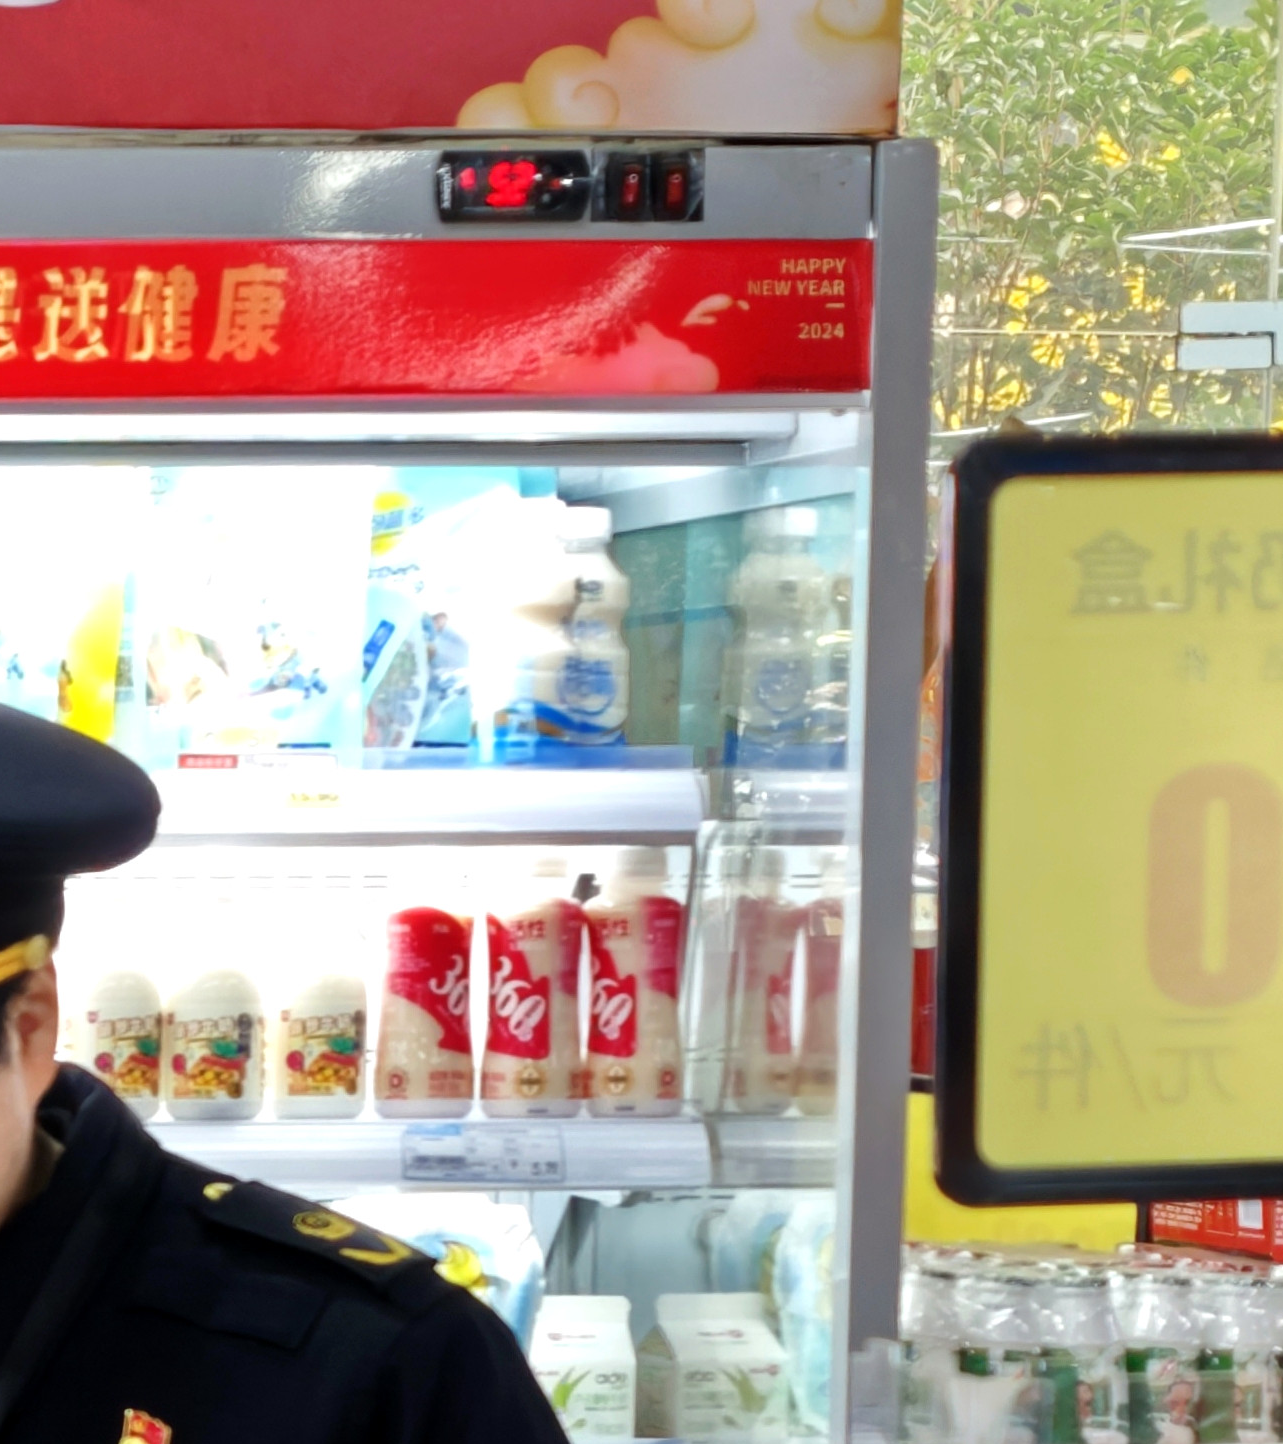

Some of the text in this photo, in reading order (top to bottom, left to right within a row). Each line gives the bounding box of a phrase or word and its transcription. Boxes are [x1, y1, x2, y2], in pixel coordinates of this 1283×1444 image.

[781, 258, 847, 274] HAPPY
[748, 280, 846, 296] NEW YEAR
[798, 322, 845, 340] 2024
